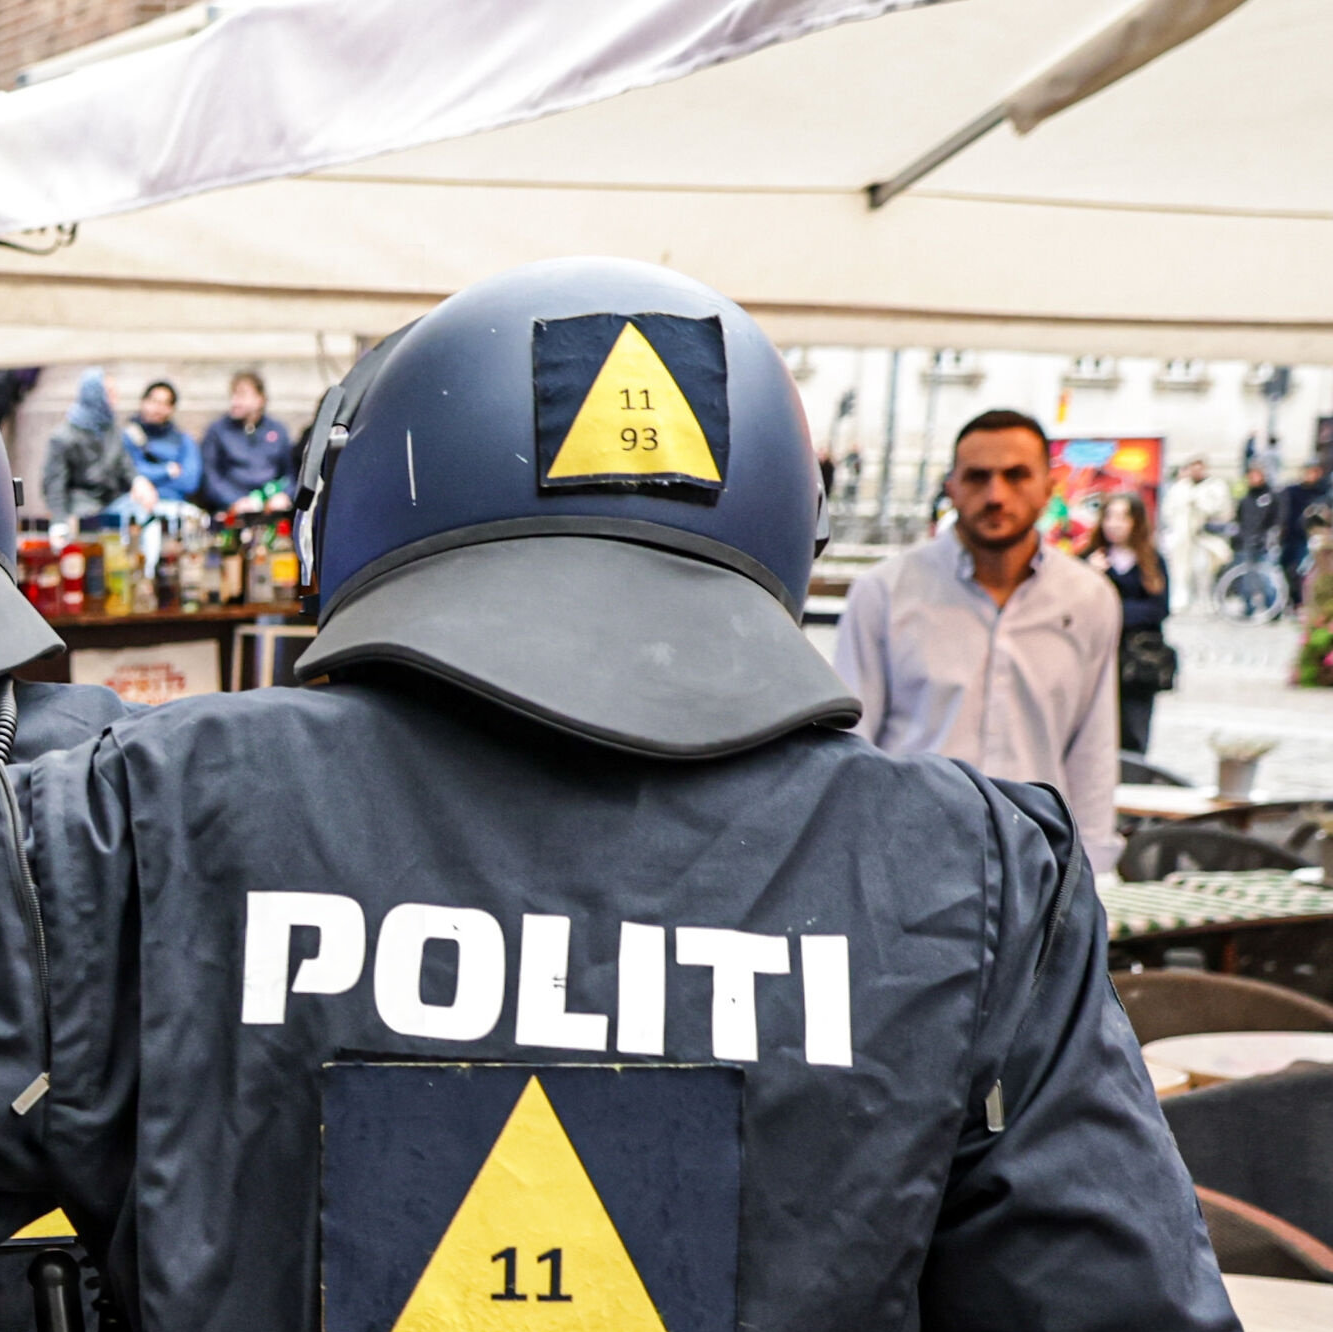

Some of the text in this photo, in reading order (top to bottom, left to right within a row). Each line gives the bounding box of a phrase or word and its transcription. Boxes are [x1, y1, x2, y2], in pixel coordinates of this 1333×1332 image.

[619, 388, 655, 410] 11
[620, 427, 659, 451] 93
[241, 890, 854, 1068] POLITI
[489, 1246, 574, 1302] 11
